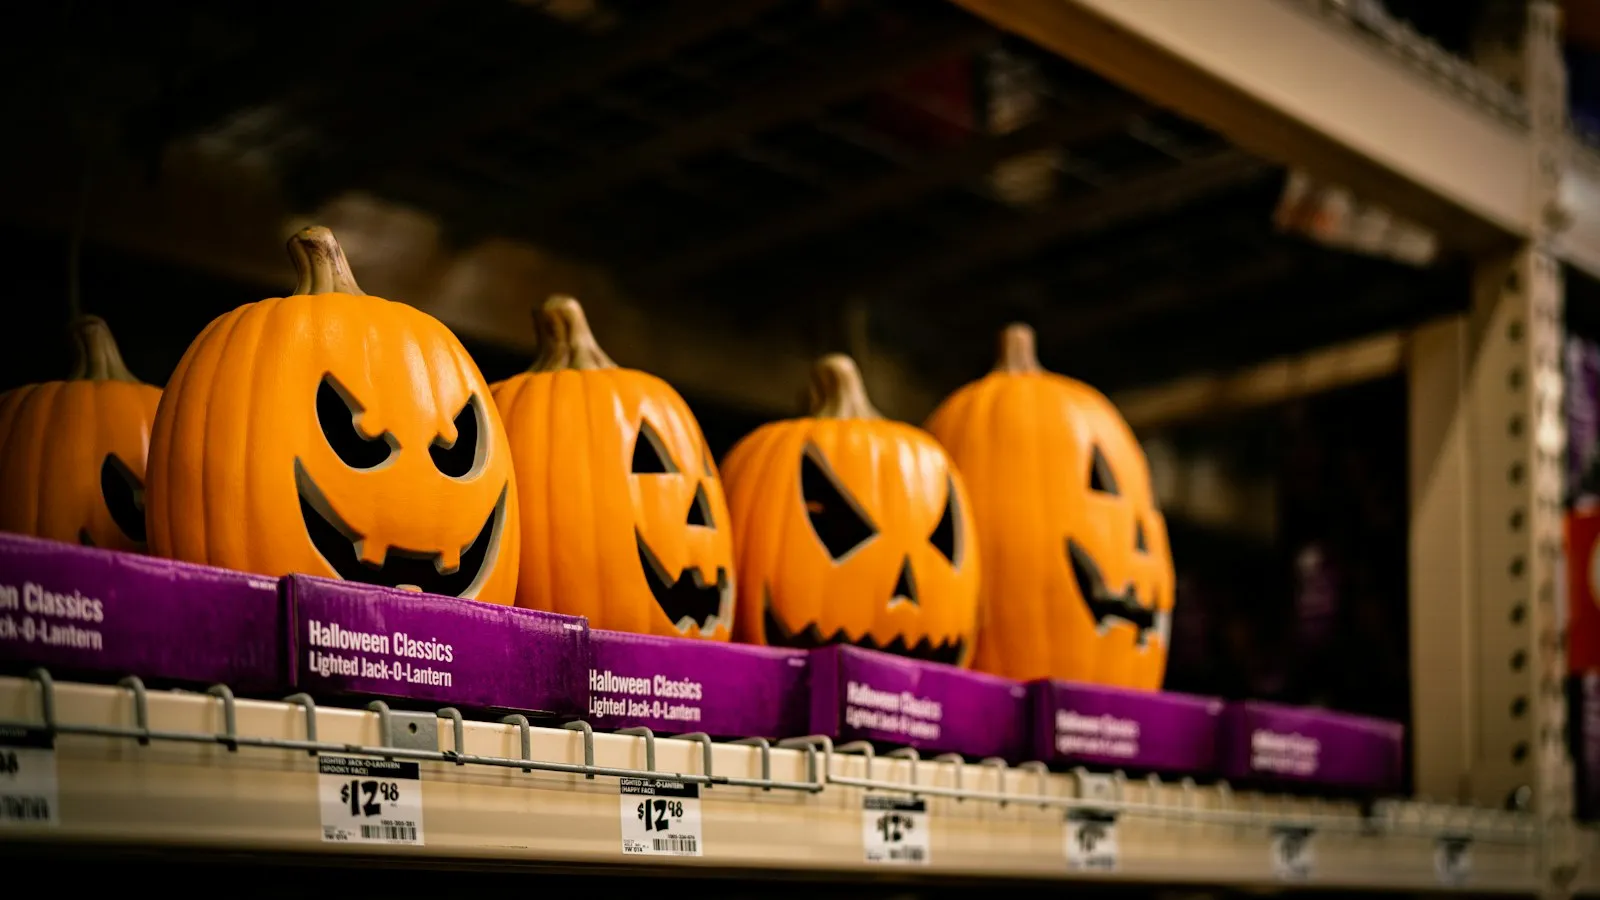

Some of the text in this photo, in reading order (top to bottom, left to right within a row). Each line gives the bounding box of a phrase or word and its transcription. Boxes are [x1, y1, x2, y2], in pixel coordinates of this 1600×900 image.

[23, 580, 104, 623] Classics
[309, 620, 453, 662] Halloween Classics
[309, 651, 452, 687] Lighted Jack-O-Lantern
[589, 669, 702, 700] Halloween Classics
[589, 696, 701, 722] Lighted Jack-O-Lantern
[642, 780, 684, 789] JA-O-LANTERN
